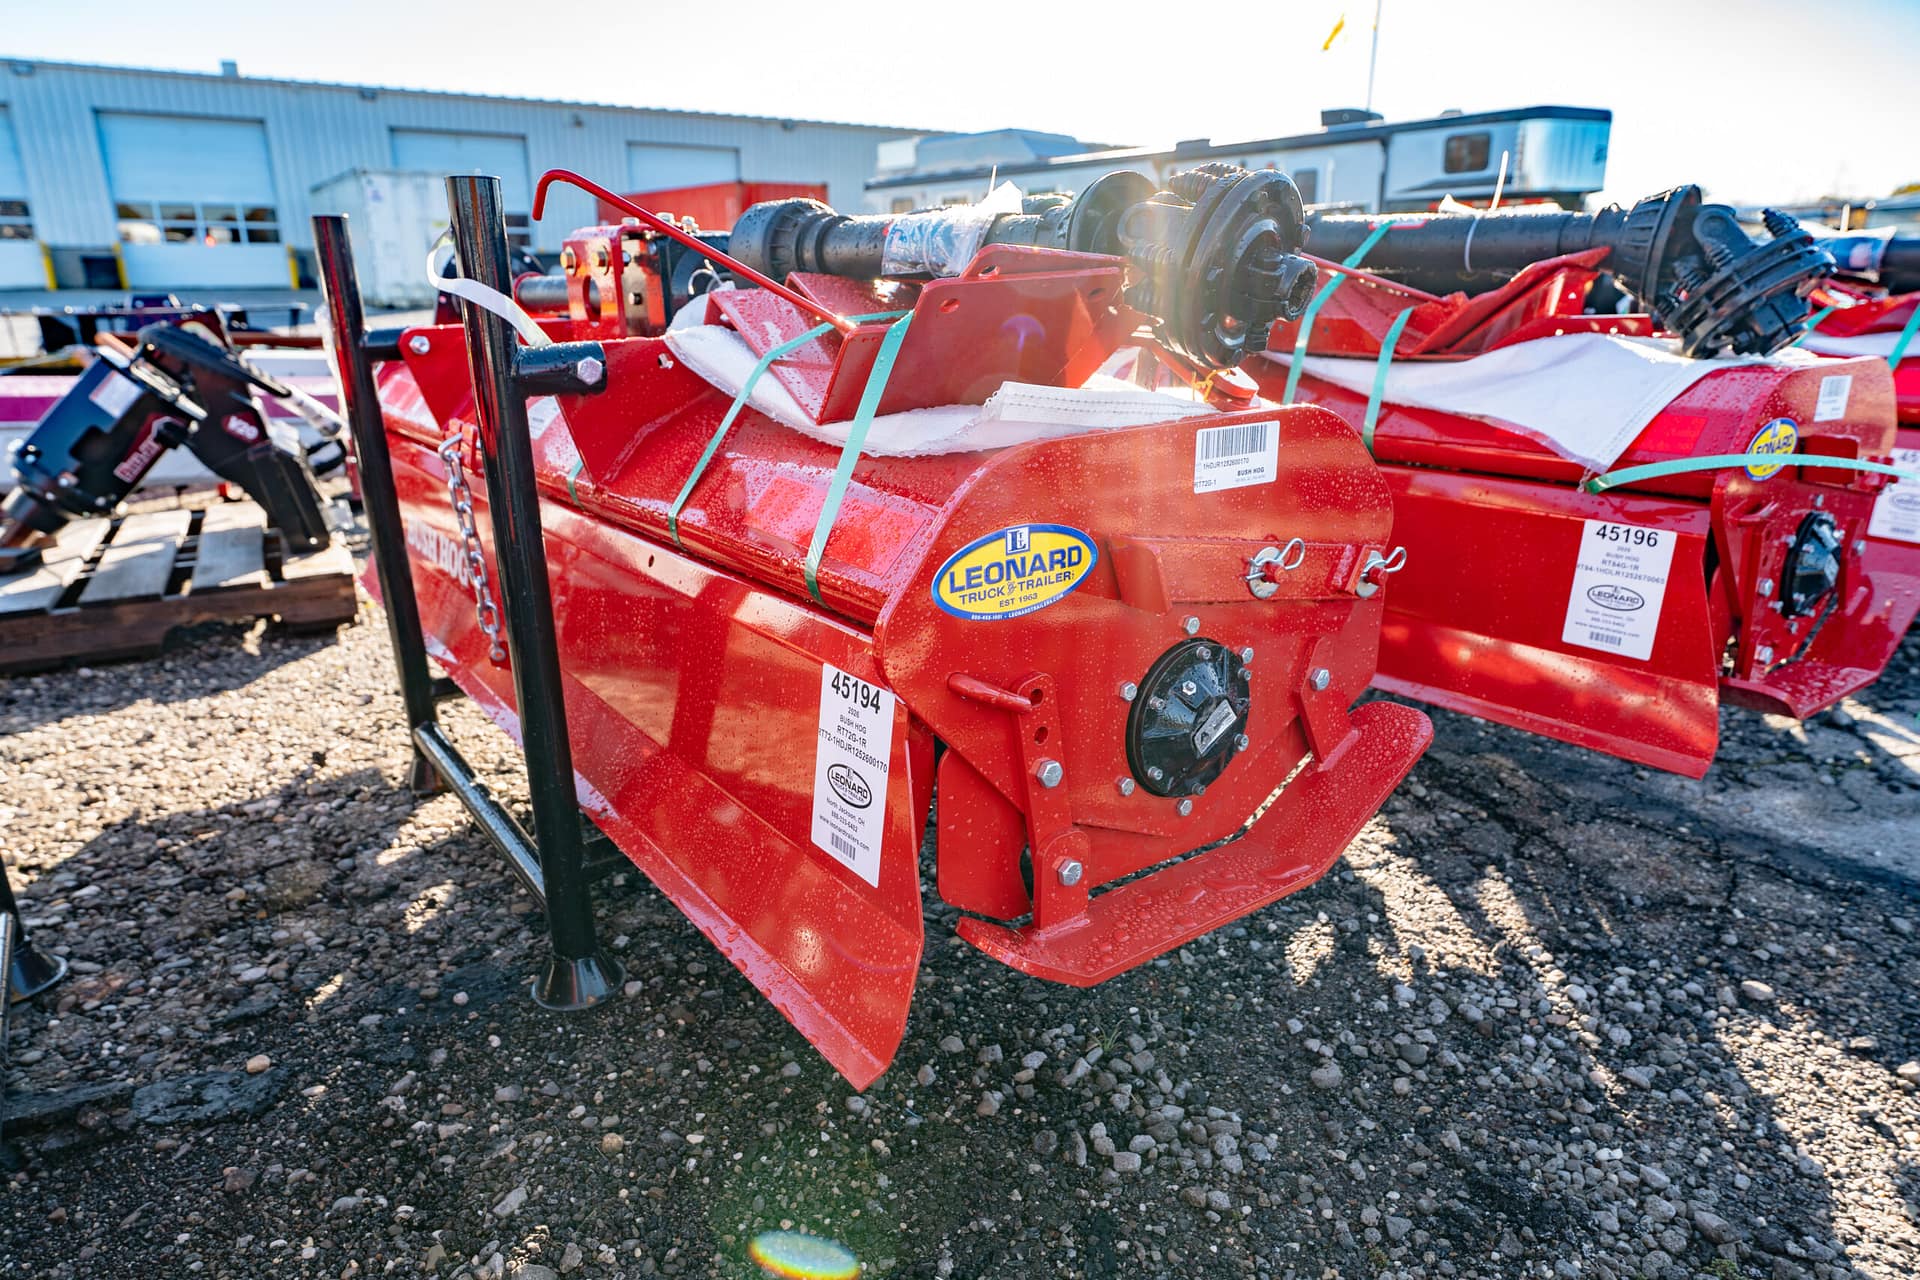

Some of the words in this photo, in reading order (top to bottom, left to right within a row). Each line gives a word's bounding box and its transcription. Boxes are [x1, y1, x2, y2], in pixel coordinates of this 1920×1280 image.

[1237, 469, 1252, 477] BUSH
[1253, 466, 1265, 474] HOG
[1596, 524, 1659, 547] 45196
[949, 545, 1083, 594] LEONARD
[959, 584, 1005, 605] TRUCK
[999, 597, 1015, 608] EST
[1592, 590, 1640, 604] LEONARD
[831, 671, 881, 715] 45194
[839, 714, 854, 728] BUSH
[855, 722, 867, 735] HOG
[836, 724, 867, 748] RT72G-1R
[831, 769, 868, 800] LEONARD
